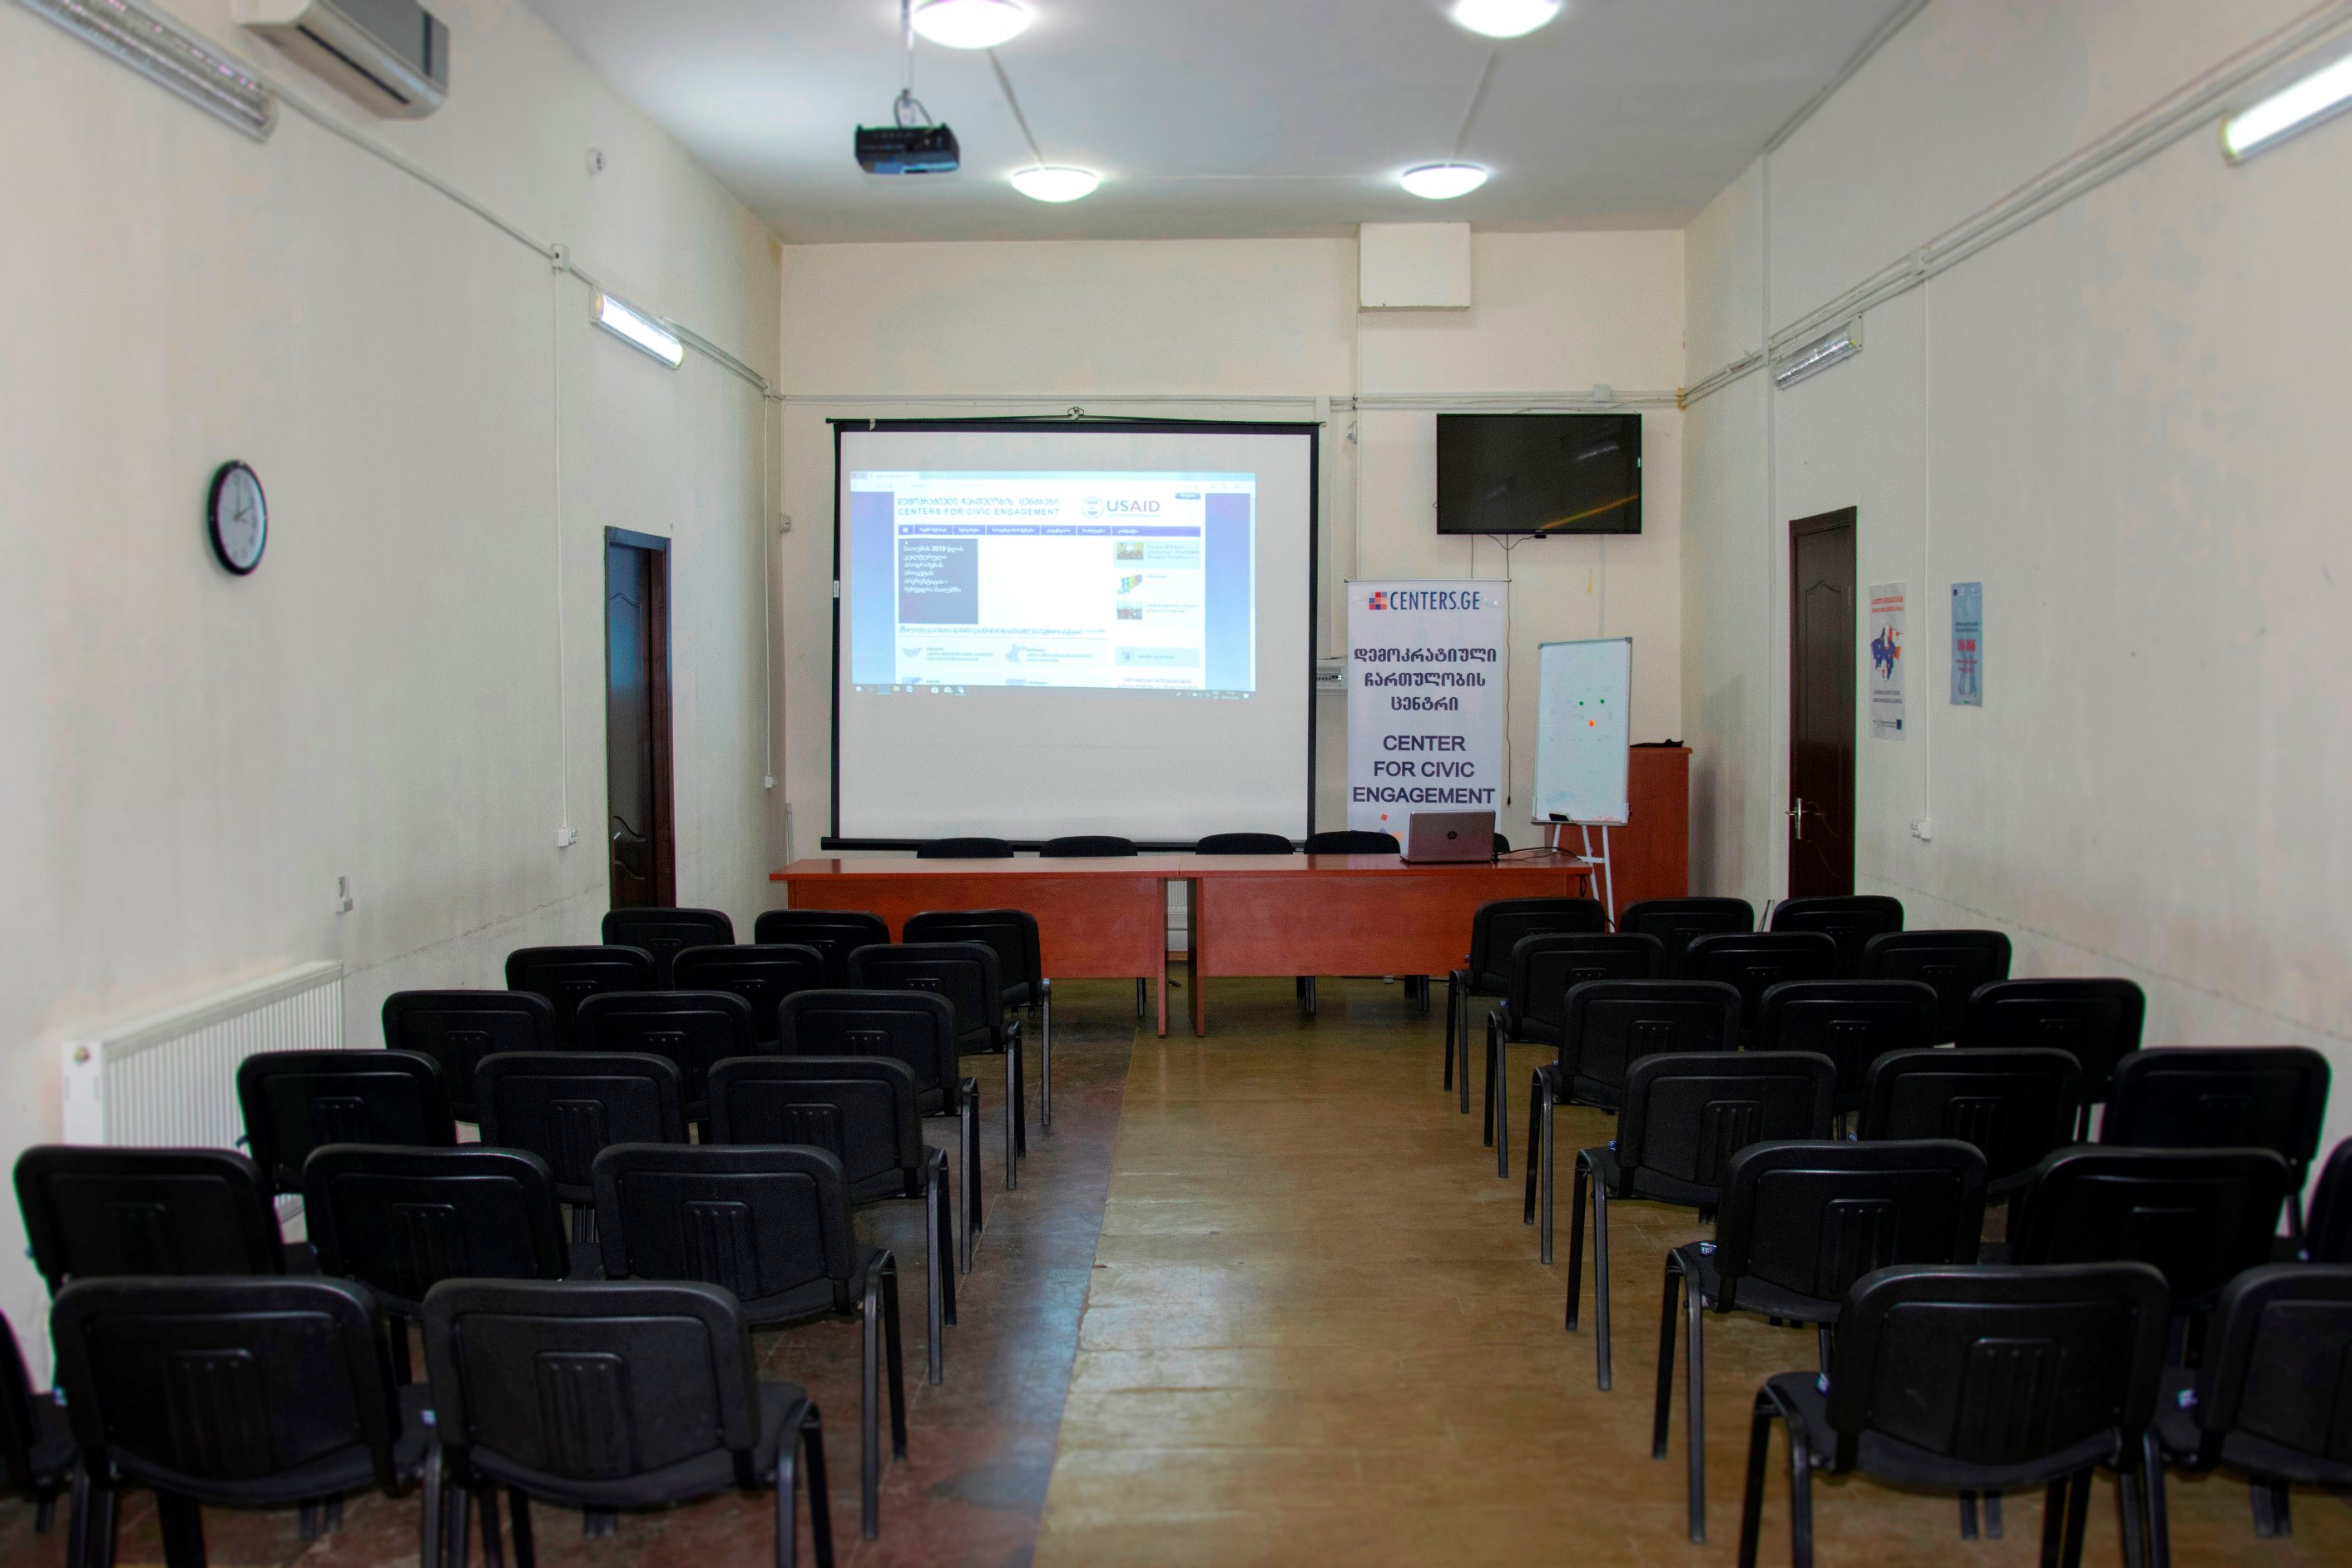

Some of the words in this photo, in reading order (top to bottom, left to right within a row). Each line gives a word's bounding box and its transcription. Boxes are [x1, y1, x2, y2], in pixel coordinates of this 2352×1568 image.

[1107, 500, 1161, 512] USAID
[1390, 591, 1480, 611] CENTERS.GE
[1354, 648, 1497, 663] დემოკრატიული
[1364, 672, 1486, 687] ჩართულობის
[1391, 696, 1458, 711] ცენტრი
[1383, 735, 1466, 752] CENTER
[1374, 761, 1416, 778] FOR
[1421, 761, 1475, 778] CIVIC
[1353, 787, 1495, 804] ENGAGEMENT
